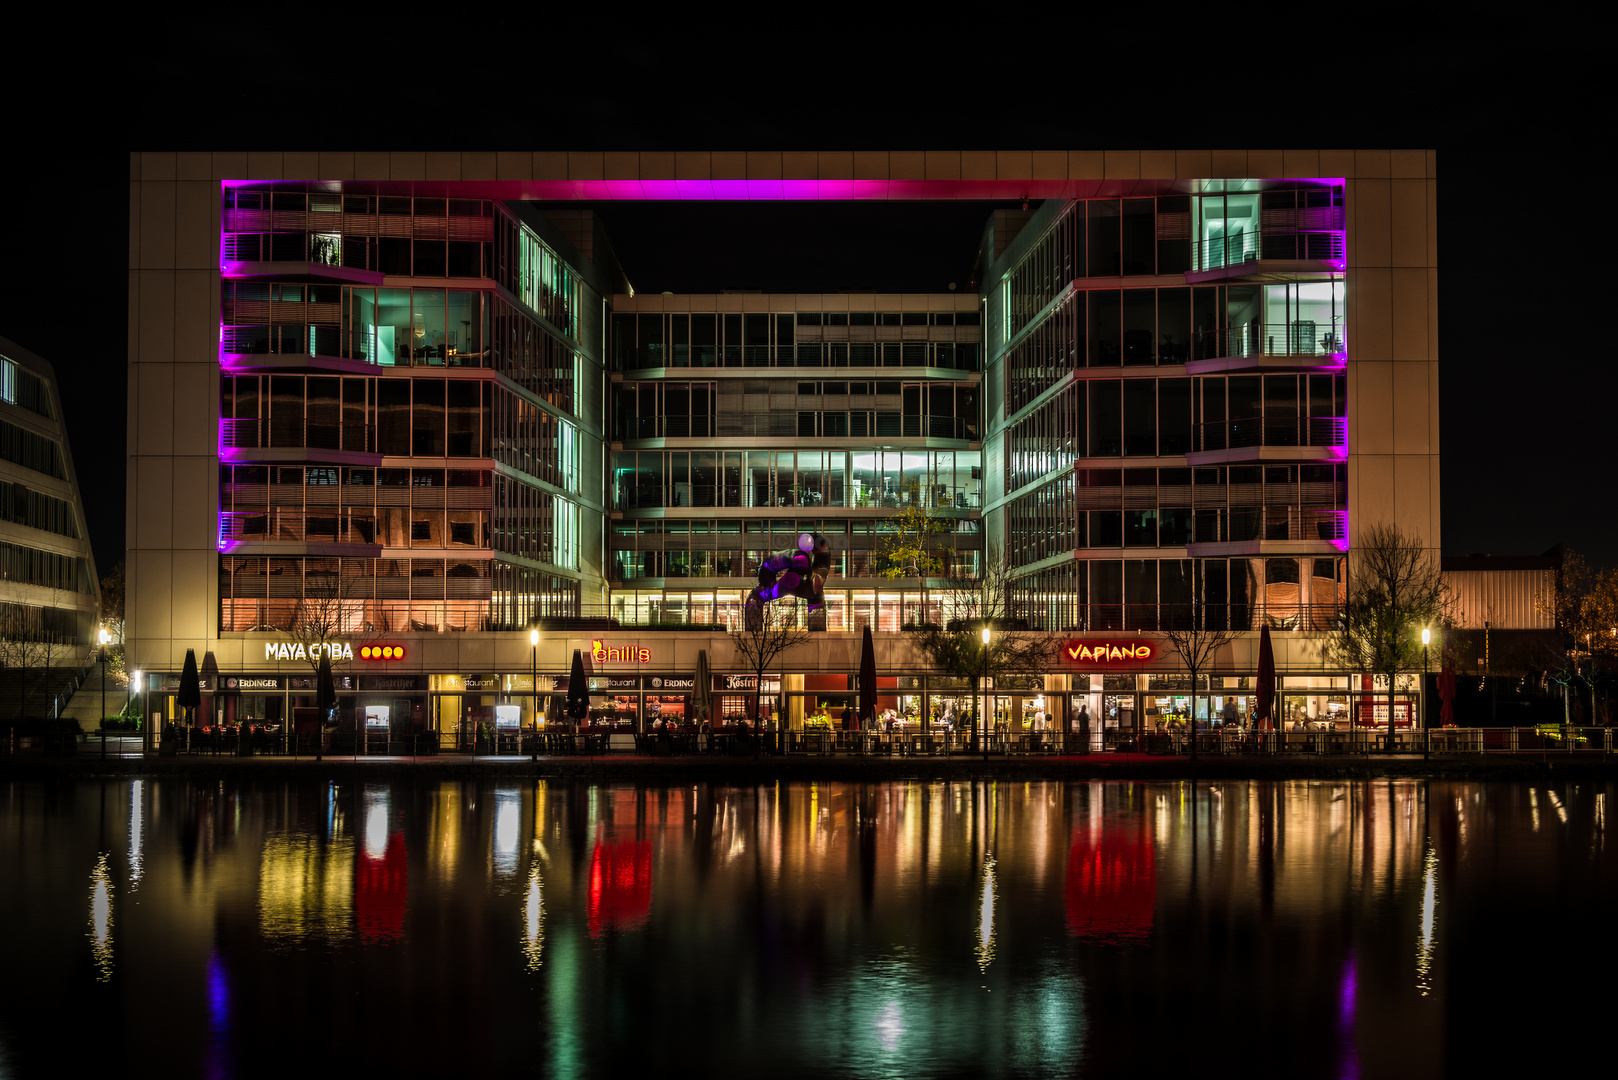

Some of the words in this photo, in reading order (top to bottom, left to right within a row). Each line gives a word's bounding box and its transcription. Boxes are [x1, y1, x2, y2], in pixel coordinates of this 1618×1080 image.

[265, 643, 306, 660] MAYA
[593, 644, 651, 664] chili's
[239, 679, 278, 688] ERDINGER
[663, 679, 695, 687] ERDING
